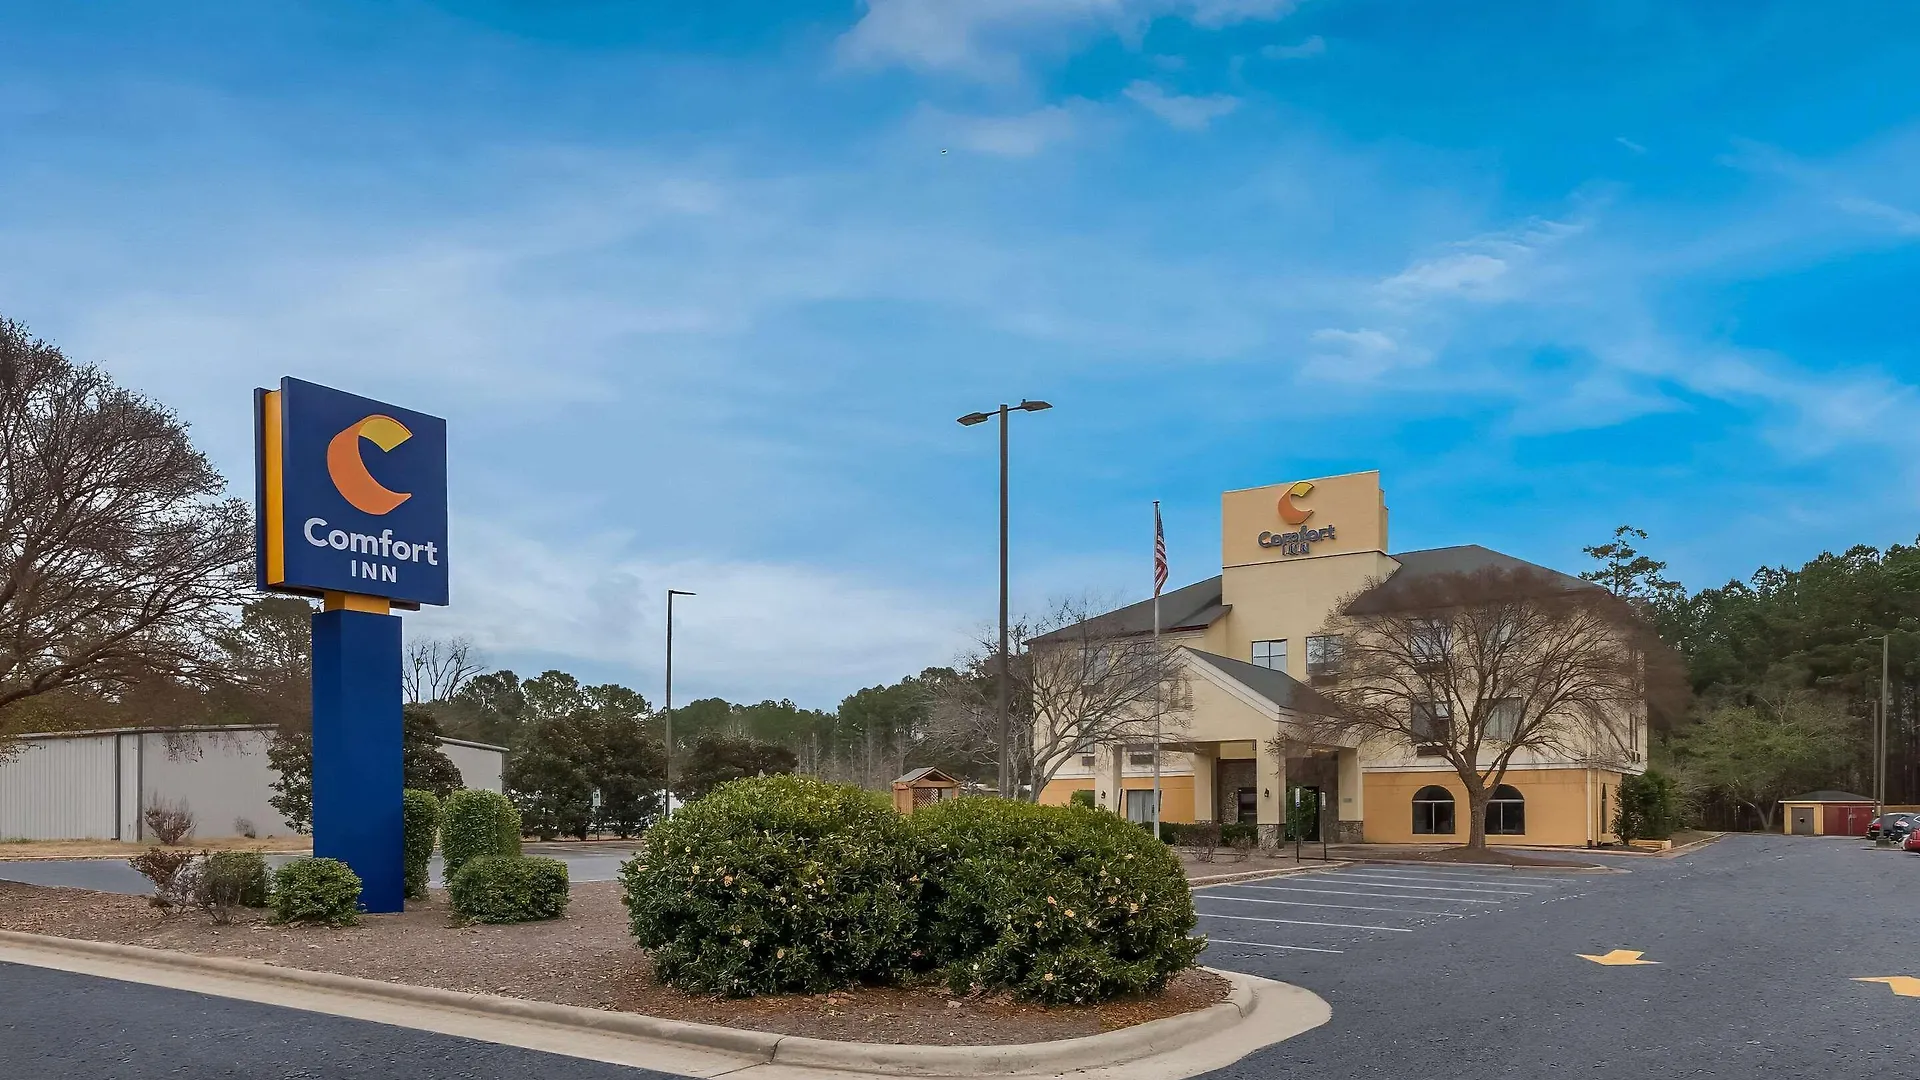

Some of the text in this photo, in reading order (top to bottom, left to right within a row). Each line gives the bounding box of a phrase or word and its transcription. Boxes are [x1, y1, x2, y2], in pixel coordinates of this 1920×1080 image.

[303, 517, 438, 566] Comfort
[1257, 524, 1336, 549] Comfort
[351, 559, 397, 583] INN
